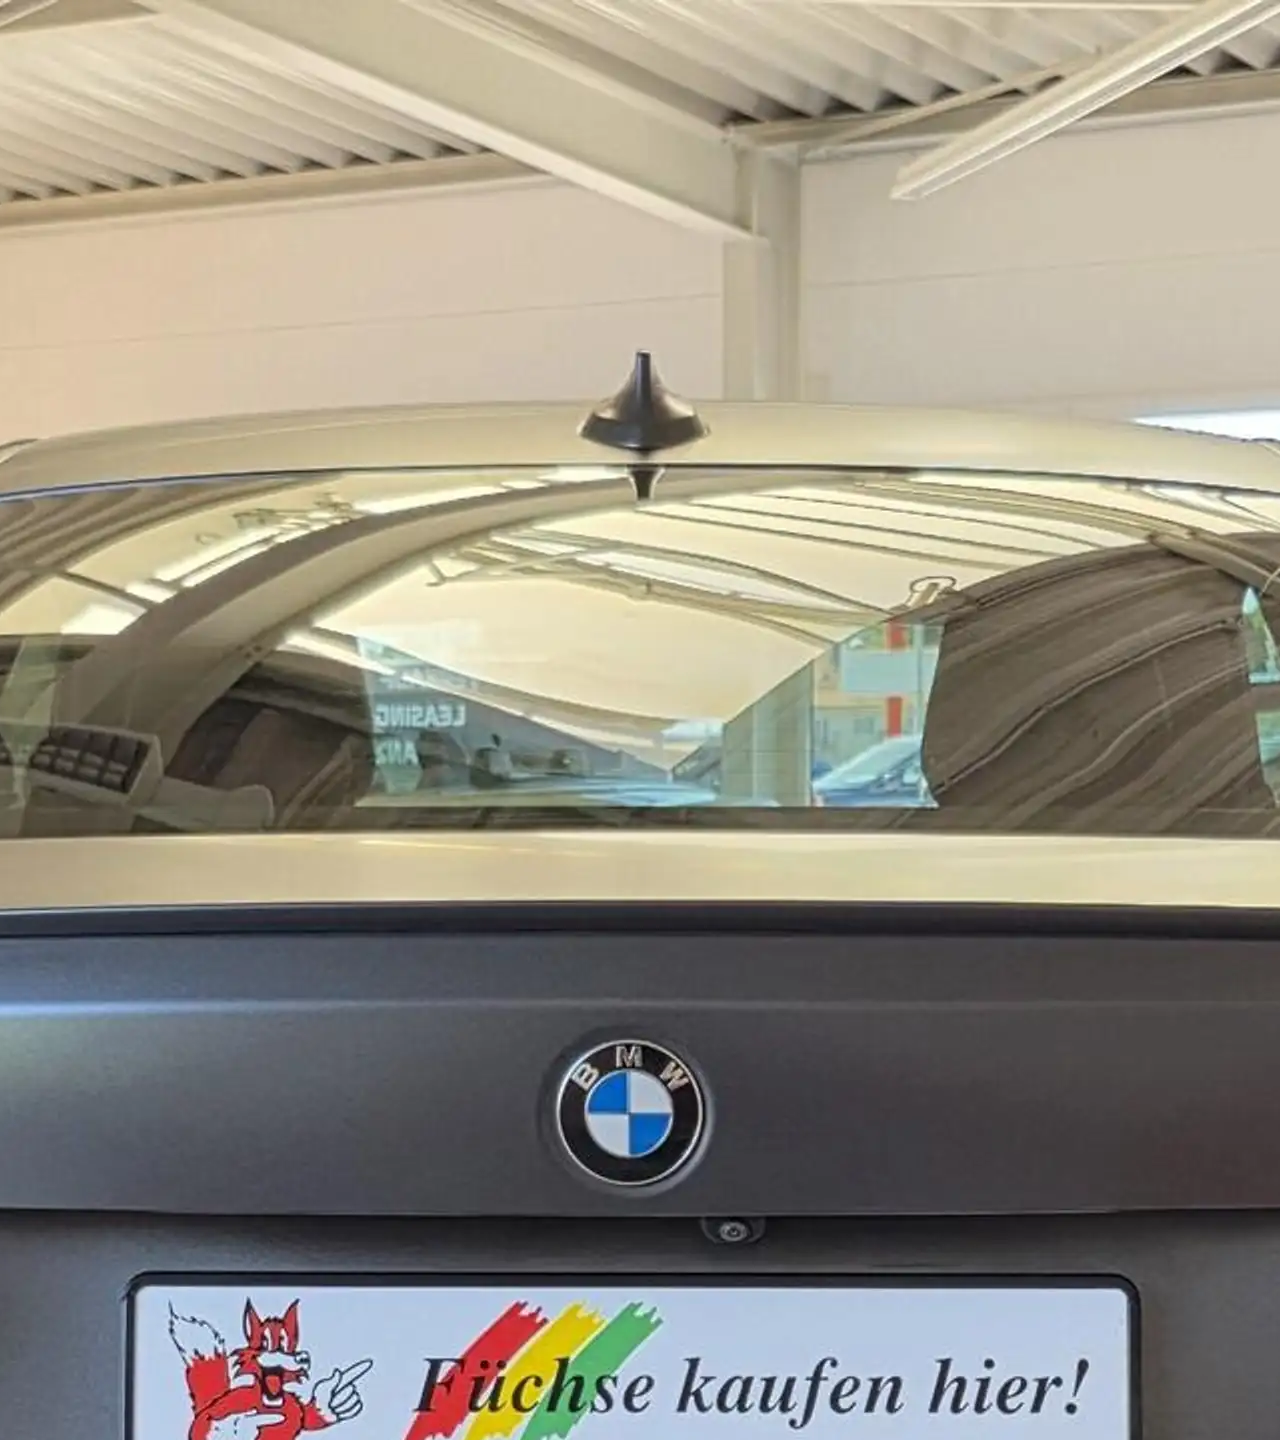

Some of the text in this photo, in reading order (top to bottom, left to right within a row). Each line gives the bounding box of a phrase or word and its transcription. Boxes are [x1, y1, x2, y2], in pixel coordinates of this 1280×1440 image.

[571, 1045, 690, 1092] BMW
[414, 1357, 1091, 1429] Füchse kaufen hier!
